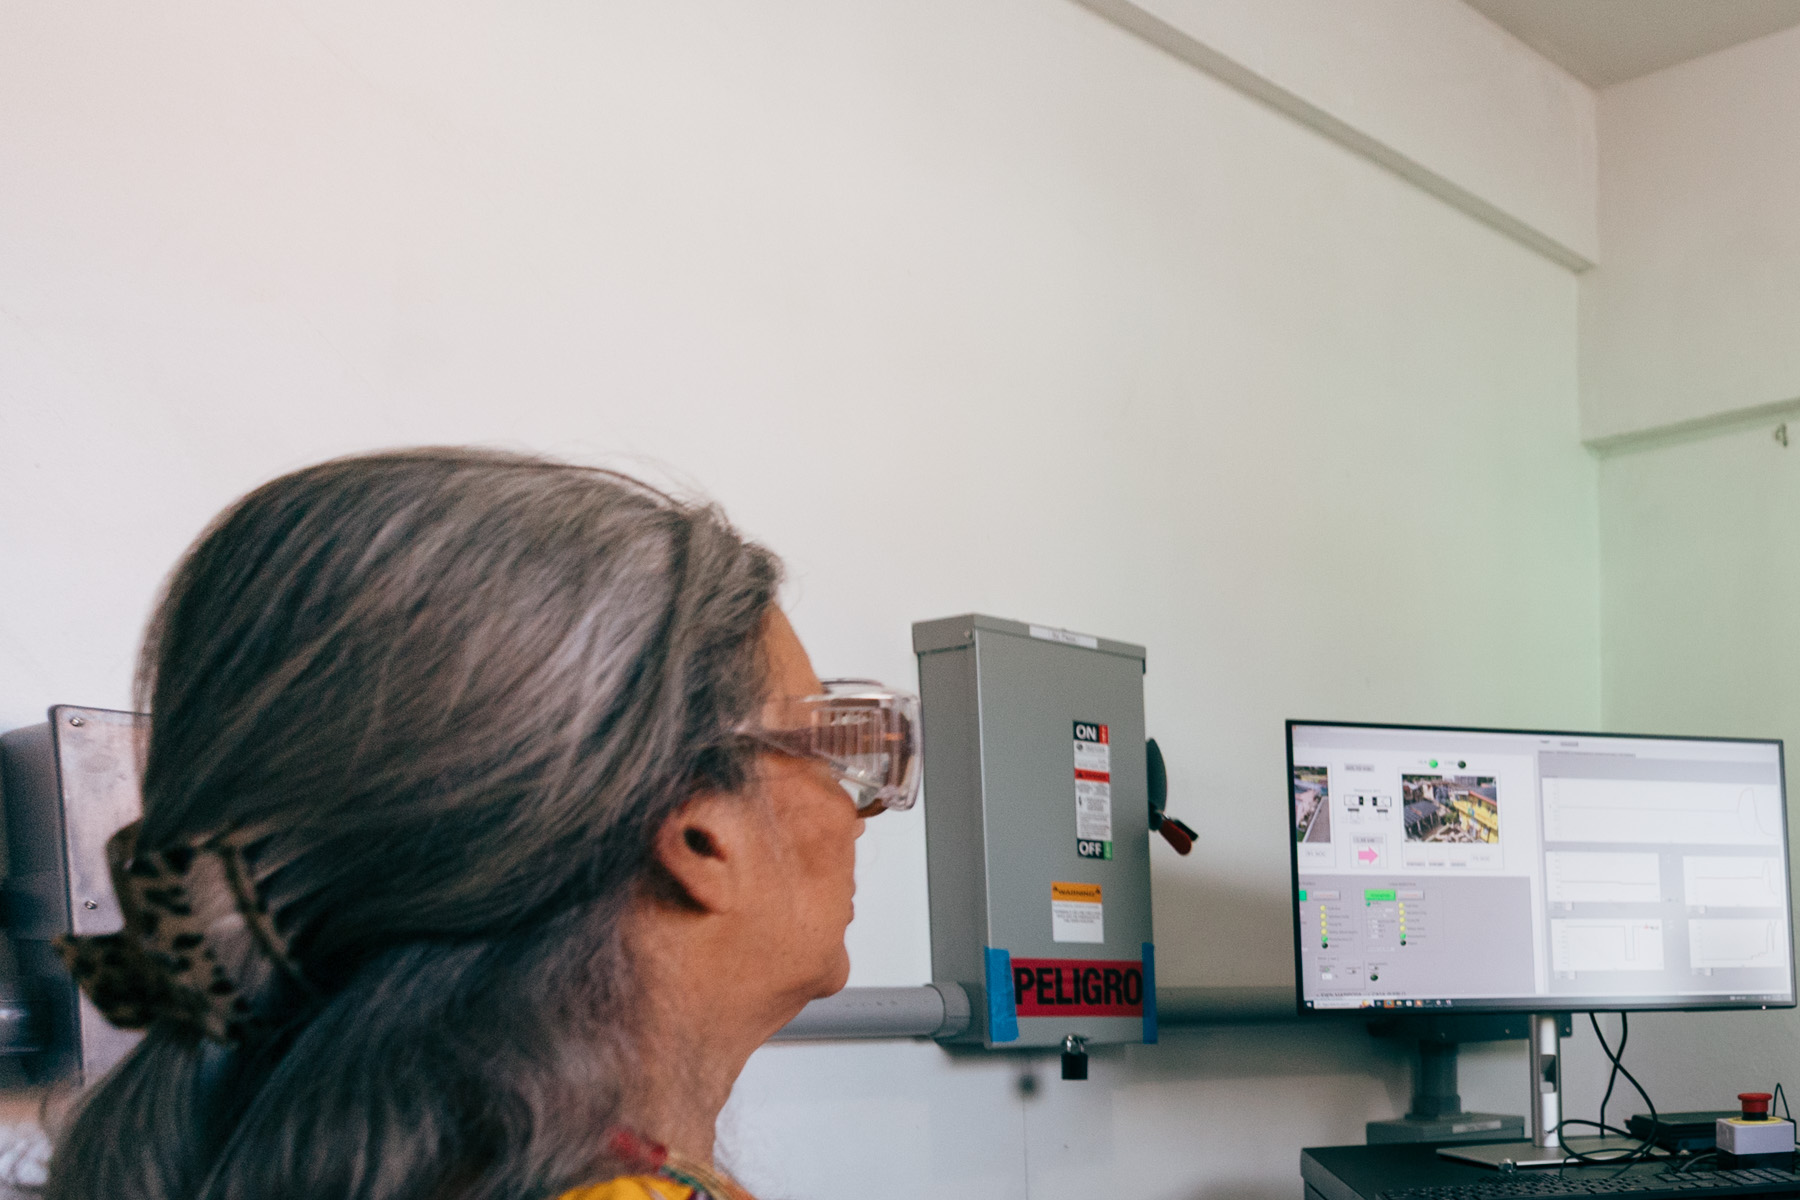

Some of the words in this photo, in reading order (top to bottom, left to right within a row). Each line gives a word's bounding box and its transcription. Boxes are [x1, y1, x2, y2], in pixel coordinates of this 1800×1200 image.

[1076, 724, 1097, 741] ON
[1079, 841, 1102, 857] OFF
[1058, 889, 1095, 898] WARNING
[1014, 967, 1143, 1005] PELIGRO
